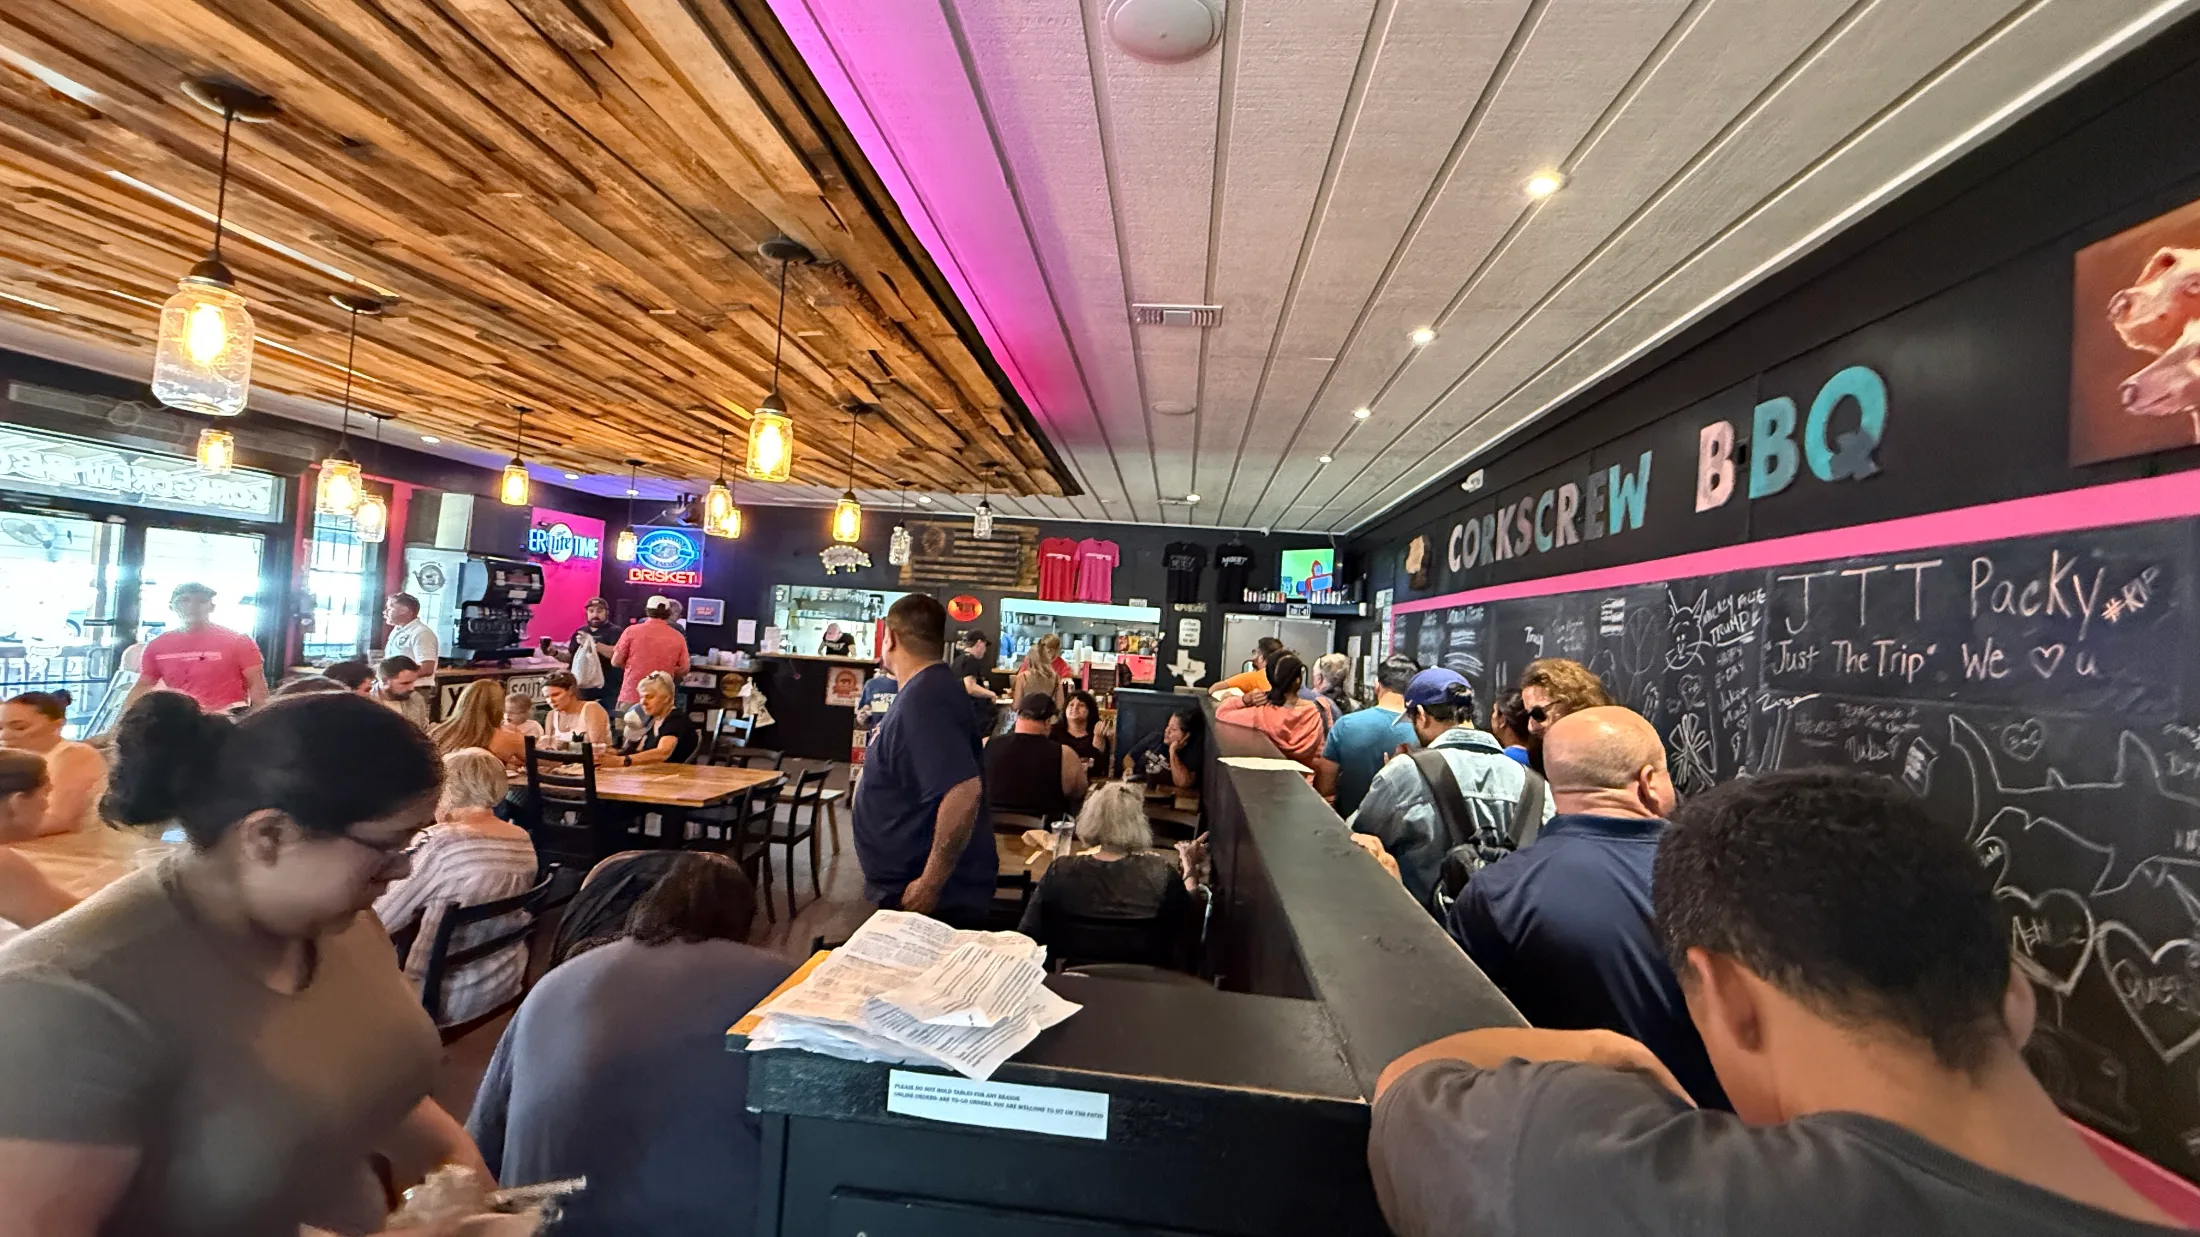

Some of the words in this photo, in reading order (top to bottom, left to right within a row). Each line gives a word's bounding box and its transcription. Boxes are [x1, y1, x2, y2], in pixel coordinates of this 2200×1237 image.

[1448, 449, 1653, 573] CORKSCREW
[1695, 365, 1888, 513] BBQ
[572, 535, 599, 559] TIME
[629, 568, 696, 584] BRISKET
[1970, 549, 2106, 642] Packy
[1961, 638, 2010, 680] We
